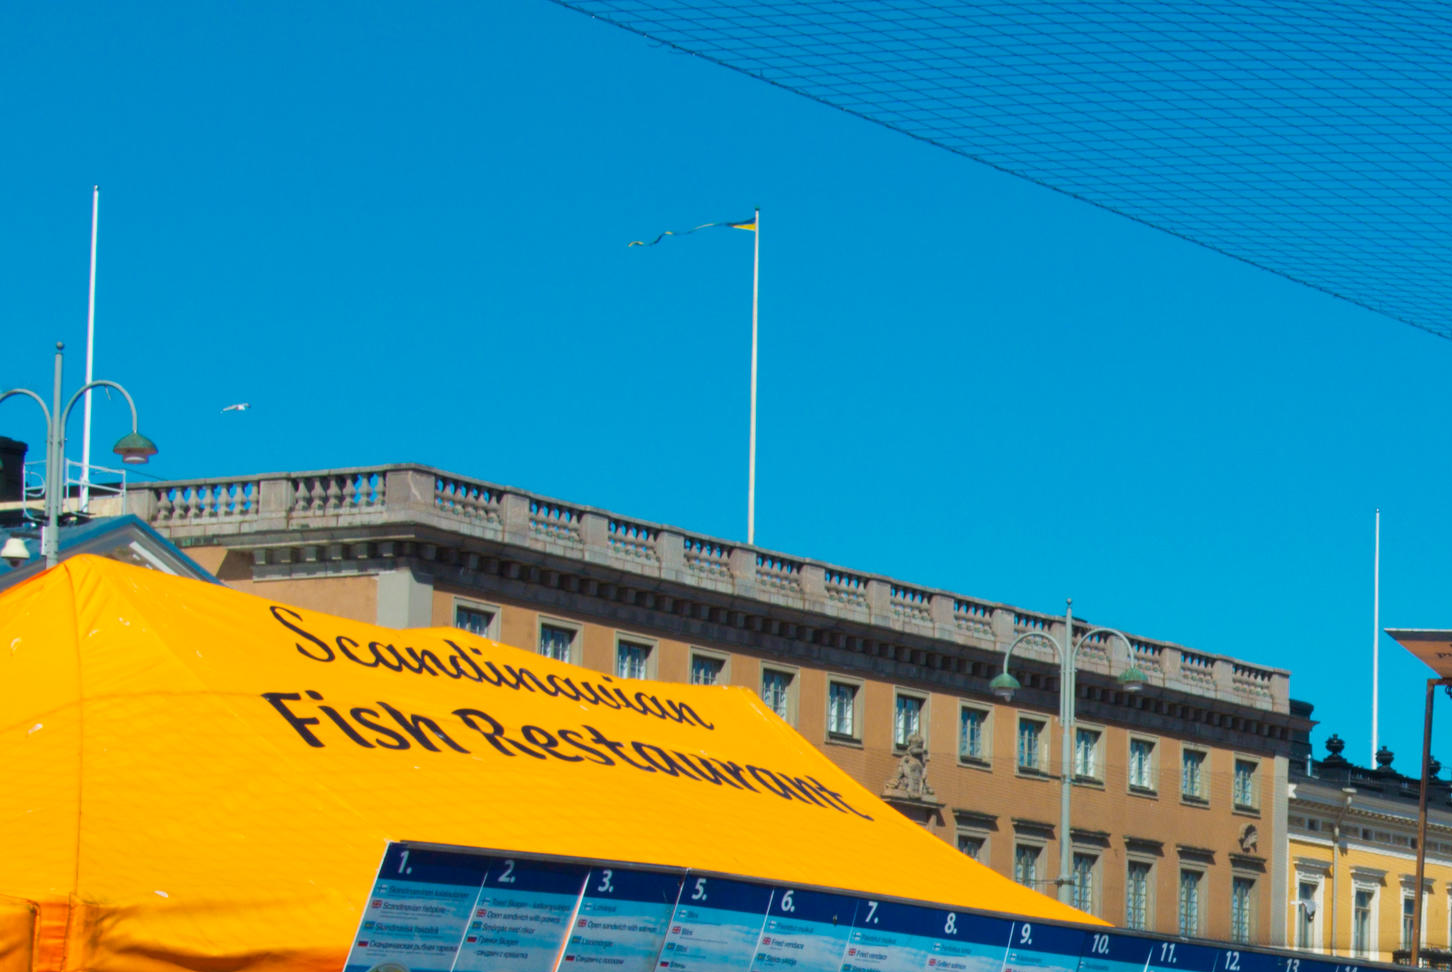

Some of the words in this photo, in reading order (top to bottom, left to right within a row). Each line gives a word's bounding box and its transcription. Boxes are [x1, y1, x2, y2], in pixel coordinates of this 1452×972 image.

[268, 605, 715, 731] Scandinavian
[260, 689, 471, 755] Fish
[451, 707, 875, 822] Restaurant
[398, 850, 413, 874] 1.
[497, 860, 516, 883] 2.
[598, 869, 614, 893] 3.
[691, 878, 707, 900] 5.
[781, 890, 795, 912] 6.
[865, 901, 879, 924] 7.
[944, 912, 957, 935] 8.
[1020, 923, 1032, 945] 9.
[1092, 934, 1109, 954] 10.
[1160, 942, 1177, 963] 11.
[1224, 951, 1240, 971] 12.
